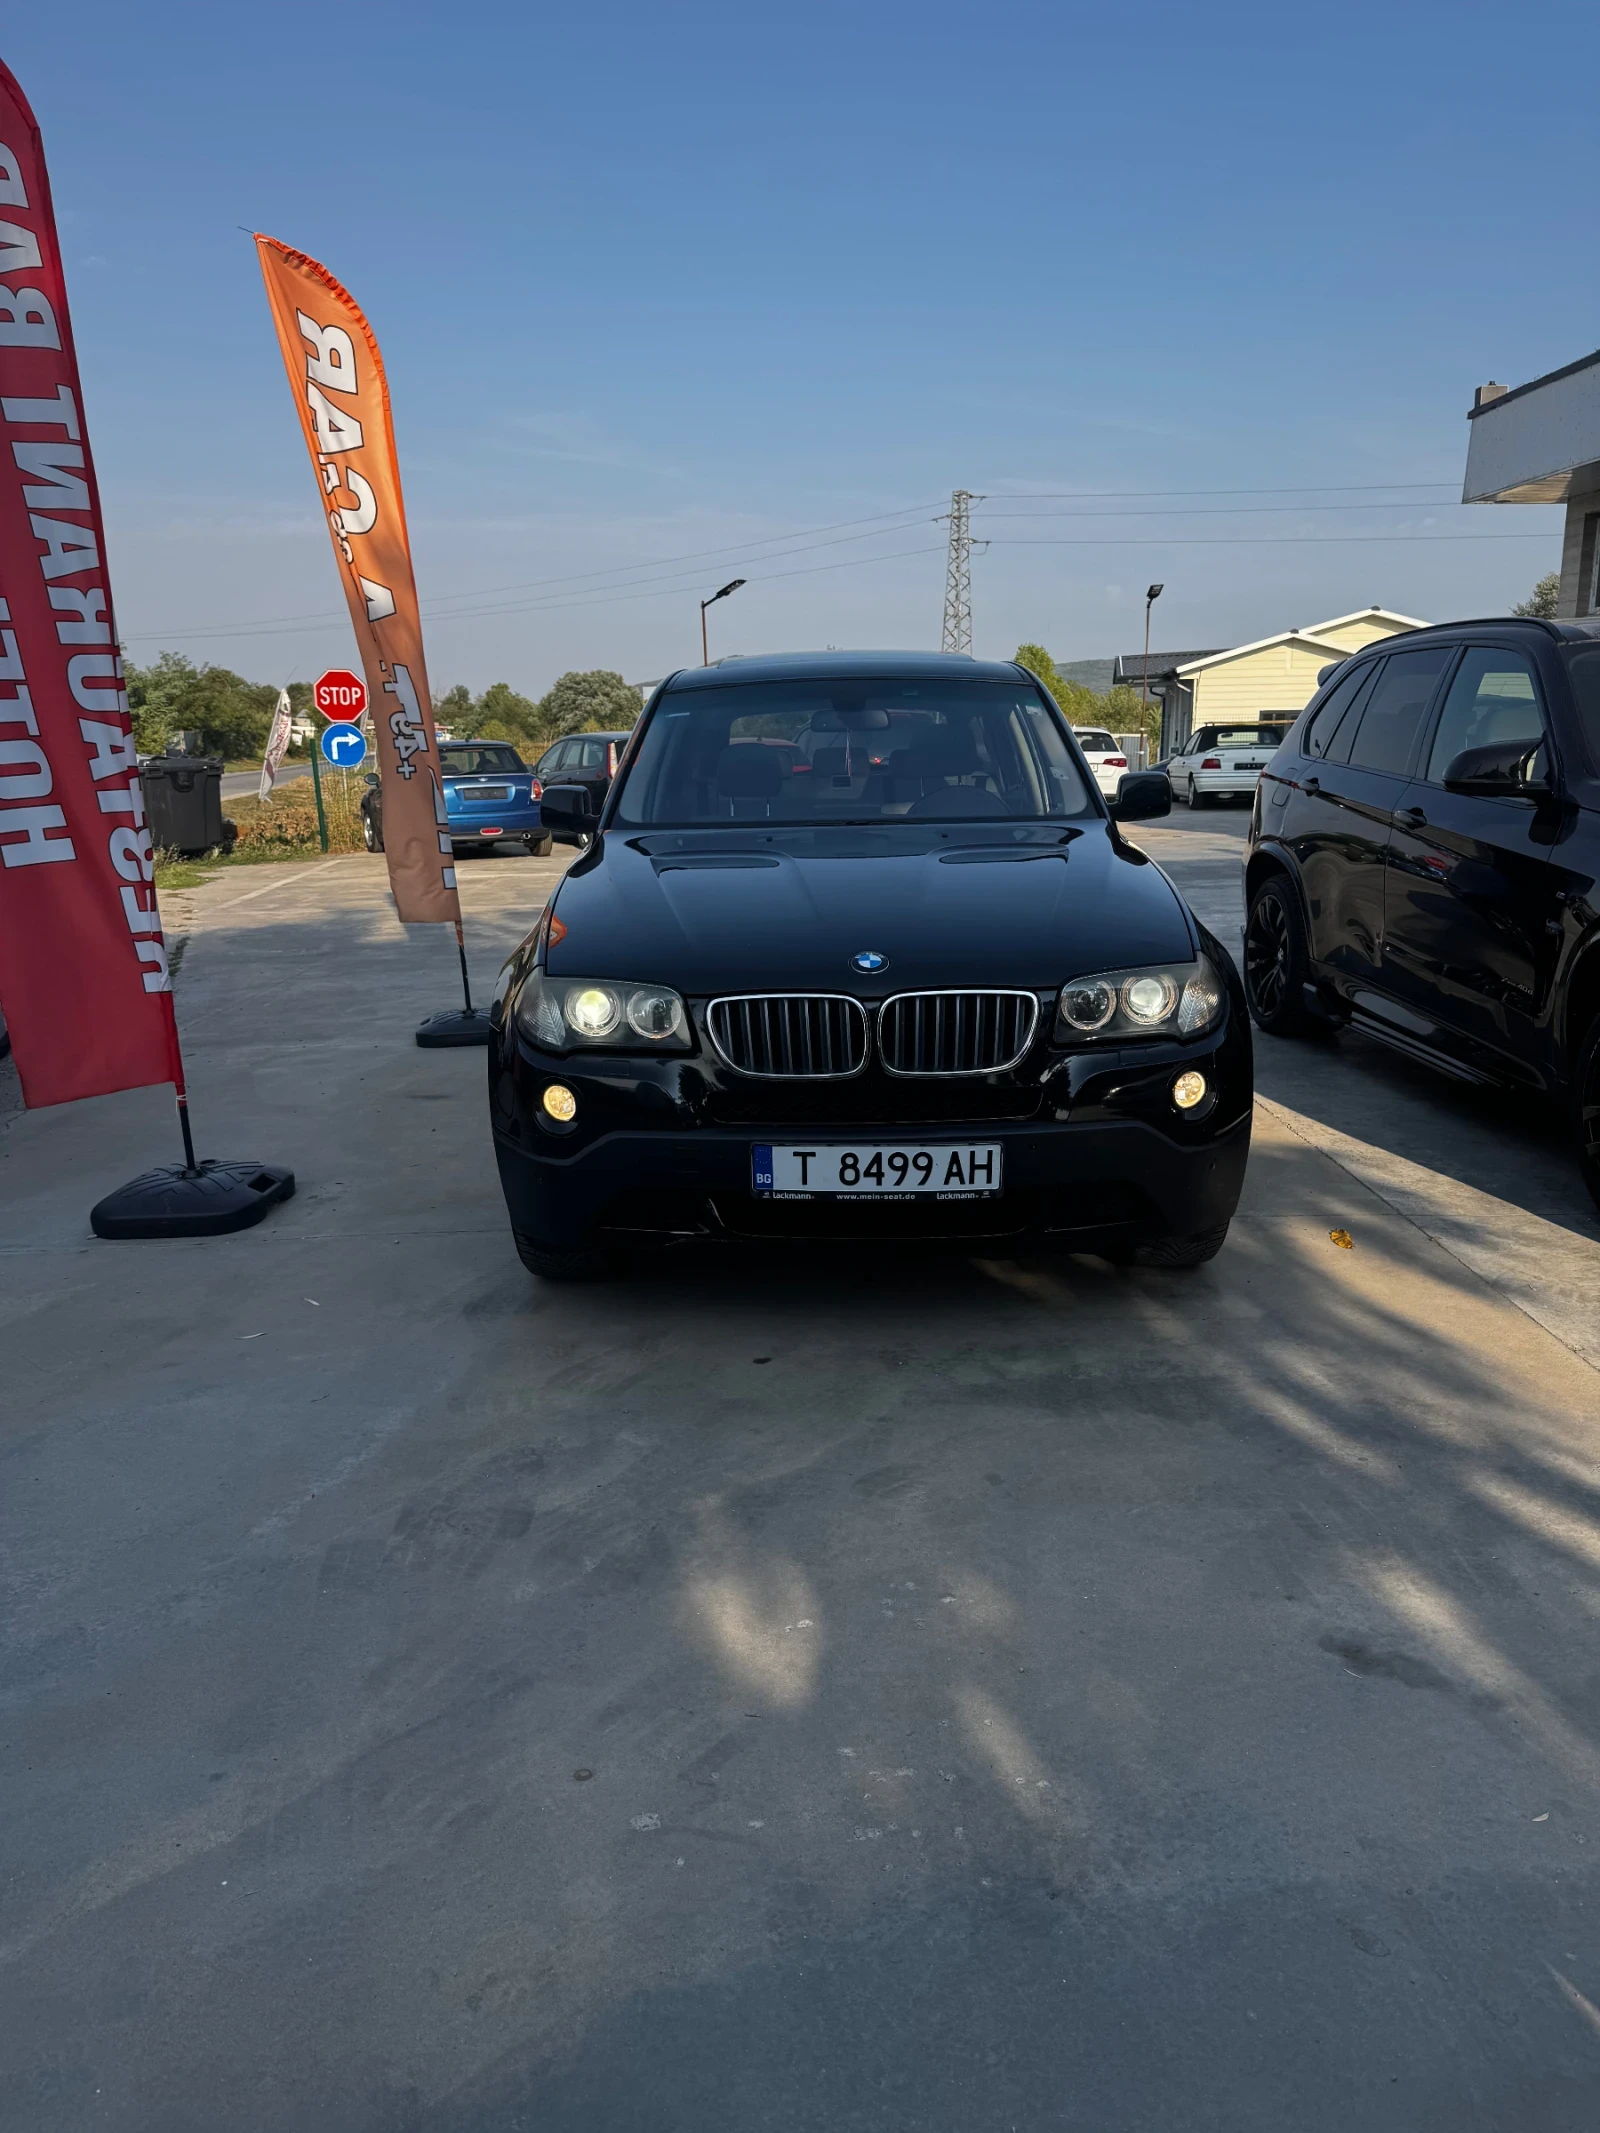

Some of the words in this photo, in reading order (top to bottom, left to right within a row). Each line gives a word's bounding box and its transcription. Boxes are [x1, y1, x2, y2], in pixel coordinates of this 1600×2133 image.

[319, 686, 362, 706] STOP
[792, 1151, 817, 1186] T
[838, 1151, 934, 1187] 8499
[943, 1149, 994, 1186] AH
[756, 1173, 772, 1184] BG
[772, 1191, 812, 1200] Lackmann
[936, 1191, 976, 1200] Lackmann
